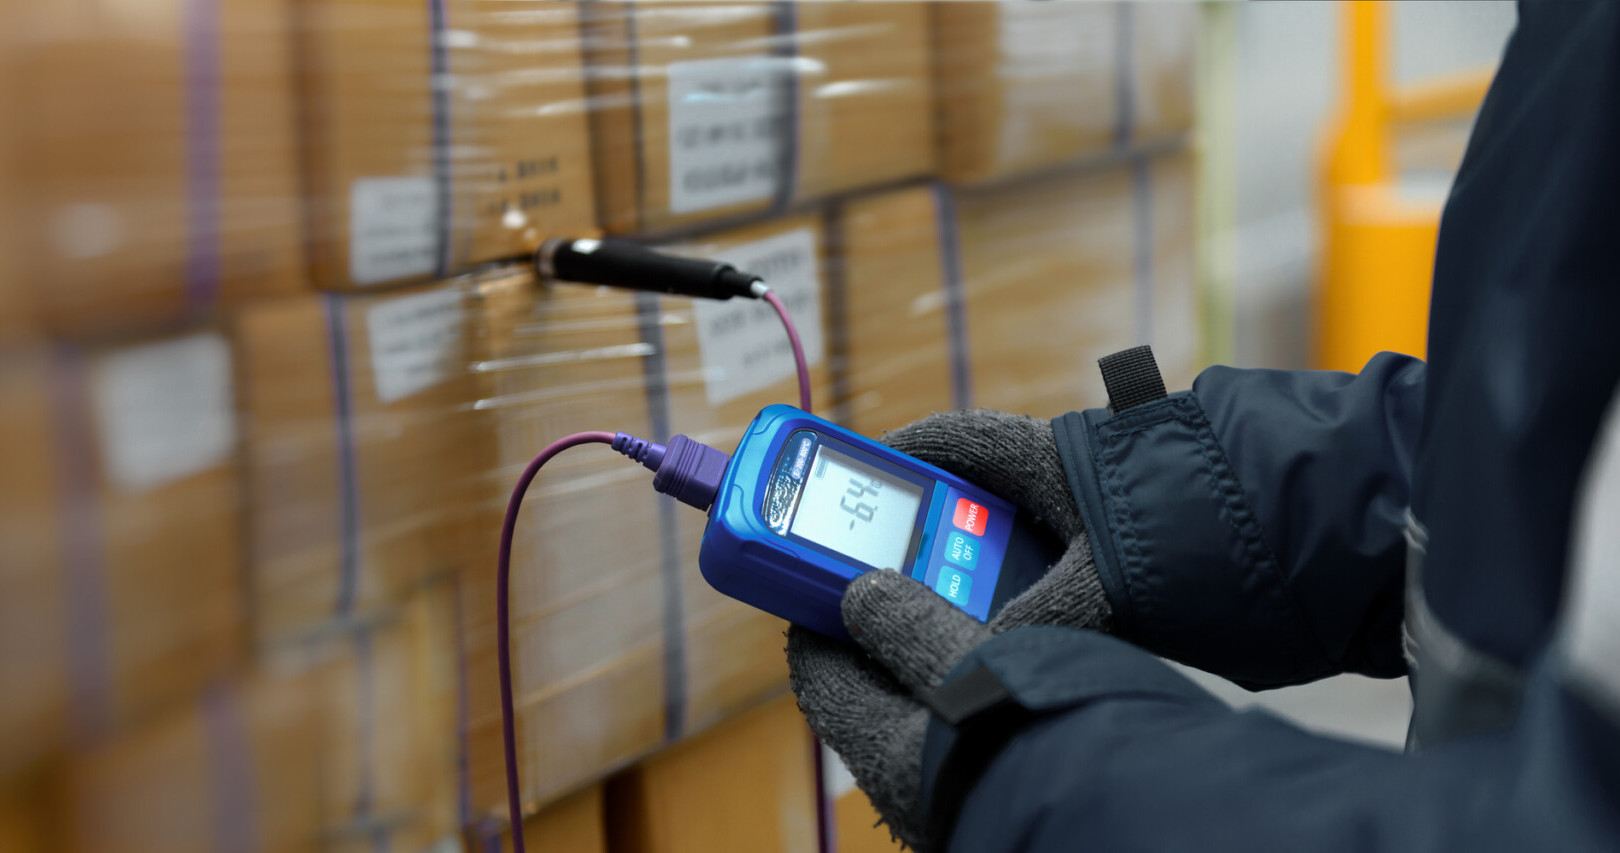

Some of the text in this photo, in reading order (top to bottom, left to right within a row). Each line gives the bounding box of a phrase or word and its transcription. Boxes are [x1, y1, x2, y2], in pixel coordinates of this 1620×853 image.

[965, 503, 980, 531] POWER
[951, 537, 964, 560] AUTO
[963, 544, 974, 561] OFF
[948, 574, 961, 598] HOLD
